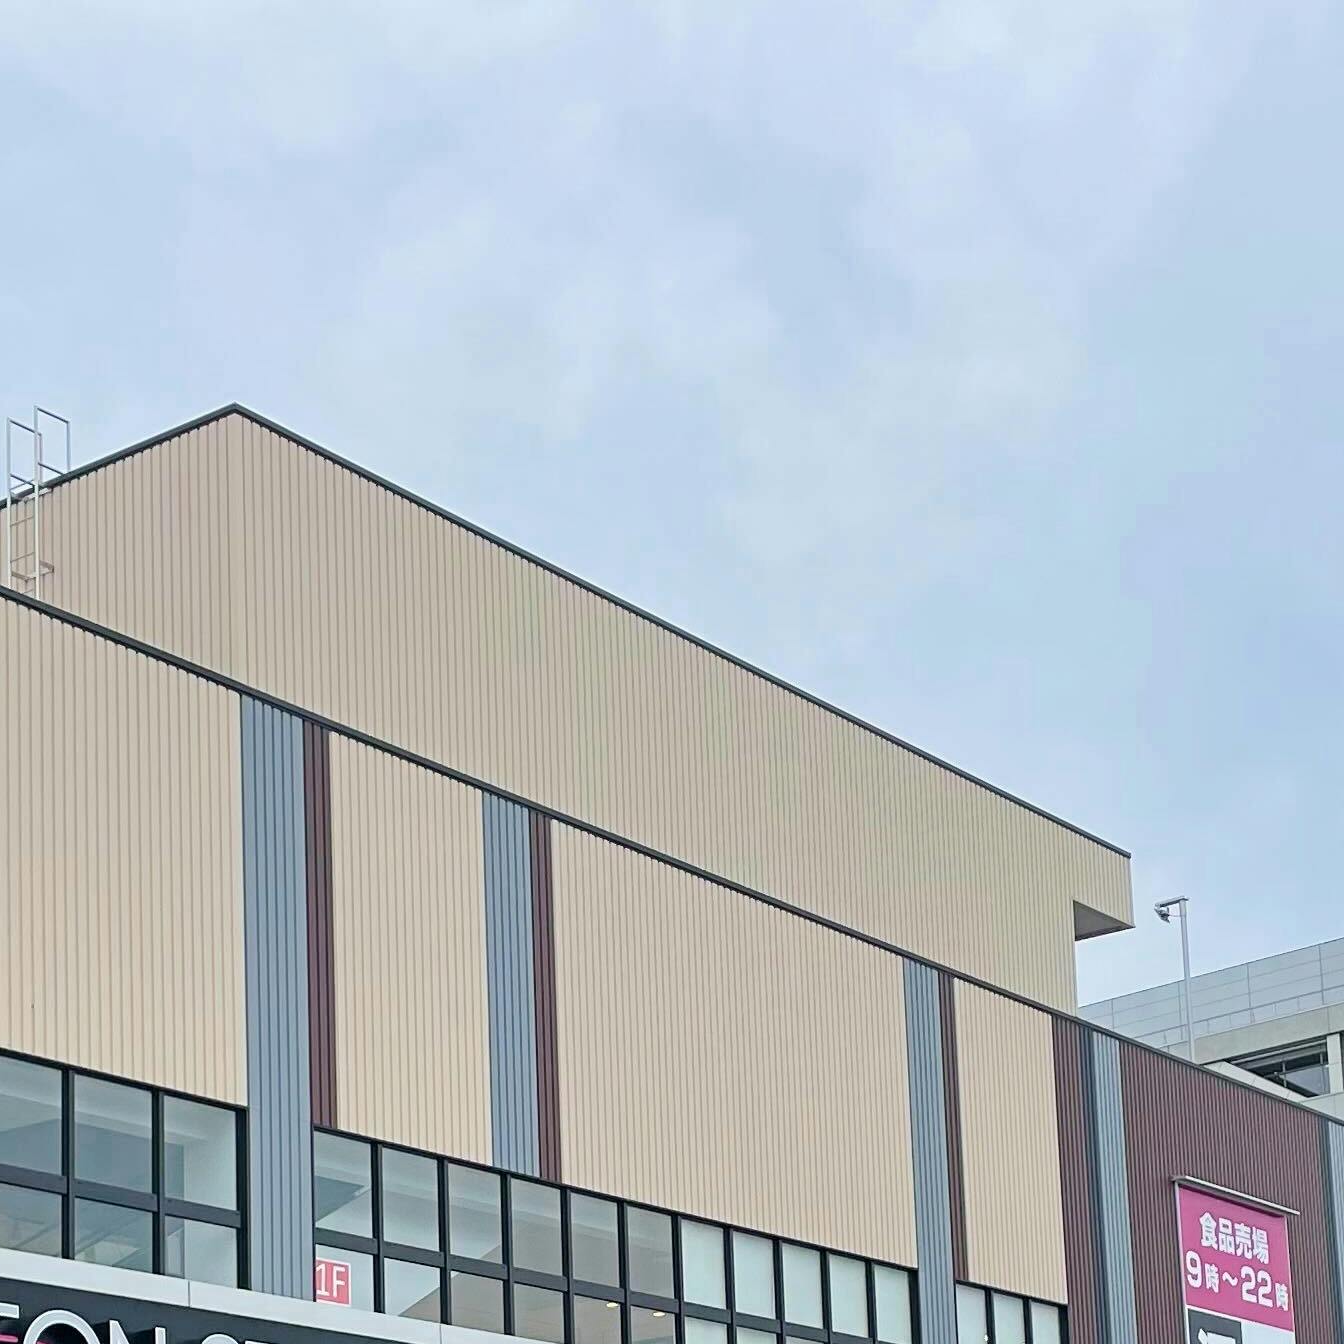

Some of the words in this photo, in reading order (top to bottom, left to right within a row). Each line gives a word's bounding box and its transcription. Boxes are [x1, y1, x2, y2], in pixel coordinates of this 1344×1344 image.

[1200, 1211, 1269, 1264] 食品売場
[316, 1264, 346, 1298] 1F
